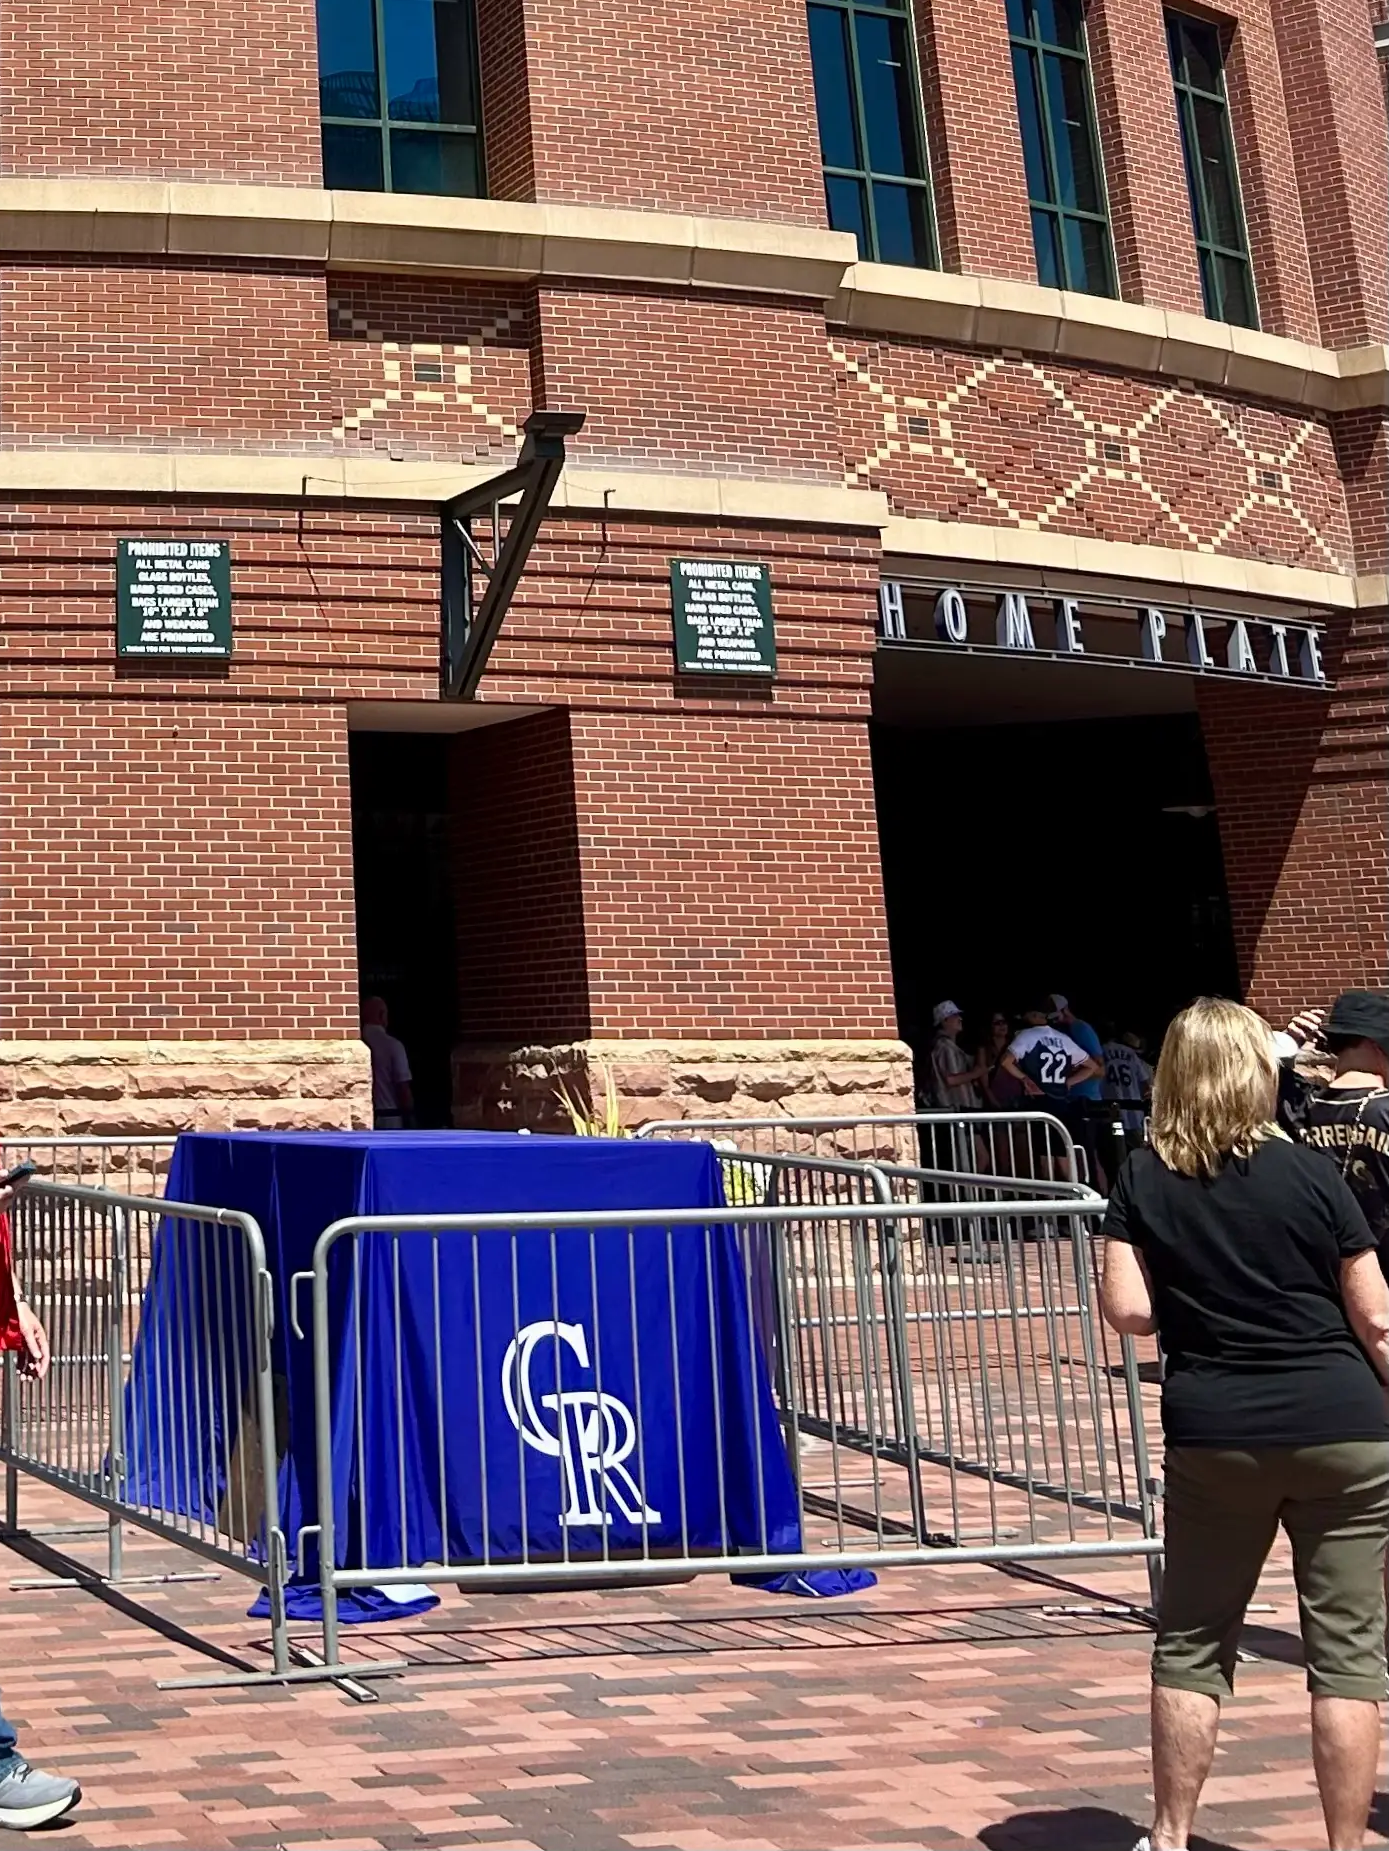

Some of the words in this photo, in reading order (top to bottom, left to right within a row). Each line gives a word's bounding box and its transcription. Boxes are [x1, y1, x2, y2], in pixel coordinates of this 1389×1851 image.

[127, 541, 188, 556] PROHIBITED
[190, 542, 221, 557] ITEMS
[135, 559, 153, 569] ALL
[154, 559, 184, 569] METAL
[138, 571, 167, 582] GLASS
[679, 562, 733, 578] PROHIBITED
[734, 564, 762, 580] ITEMS
[688, 579, 703, 589] ALL
[704, 580, 731, 590] METAL
[194, 598, 219, 608] THAN
[161, 607, 169, 616] X
[188, 607, 196, 616] X
[142, 619, 163, 629] AND
[164, 620, 209, 629] WEAPONS
[879, 581, 1084, 654] HOME
[1139, 607, 1327, 681] PLATE
[140, 632, 159, 642] ARE
[1040, 1052, 1067, 1084] 22
[1107, 1063, 1132, 1088] 46
[502, 1320, 661, 1526] CR
